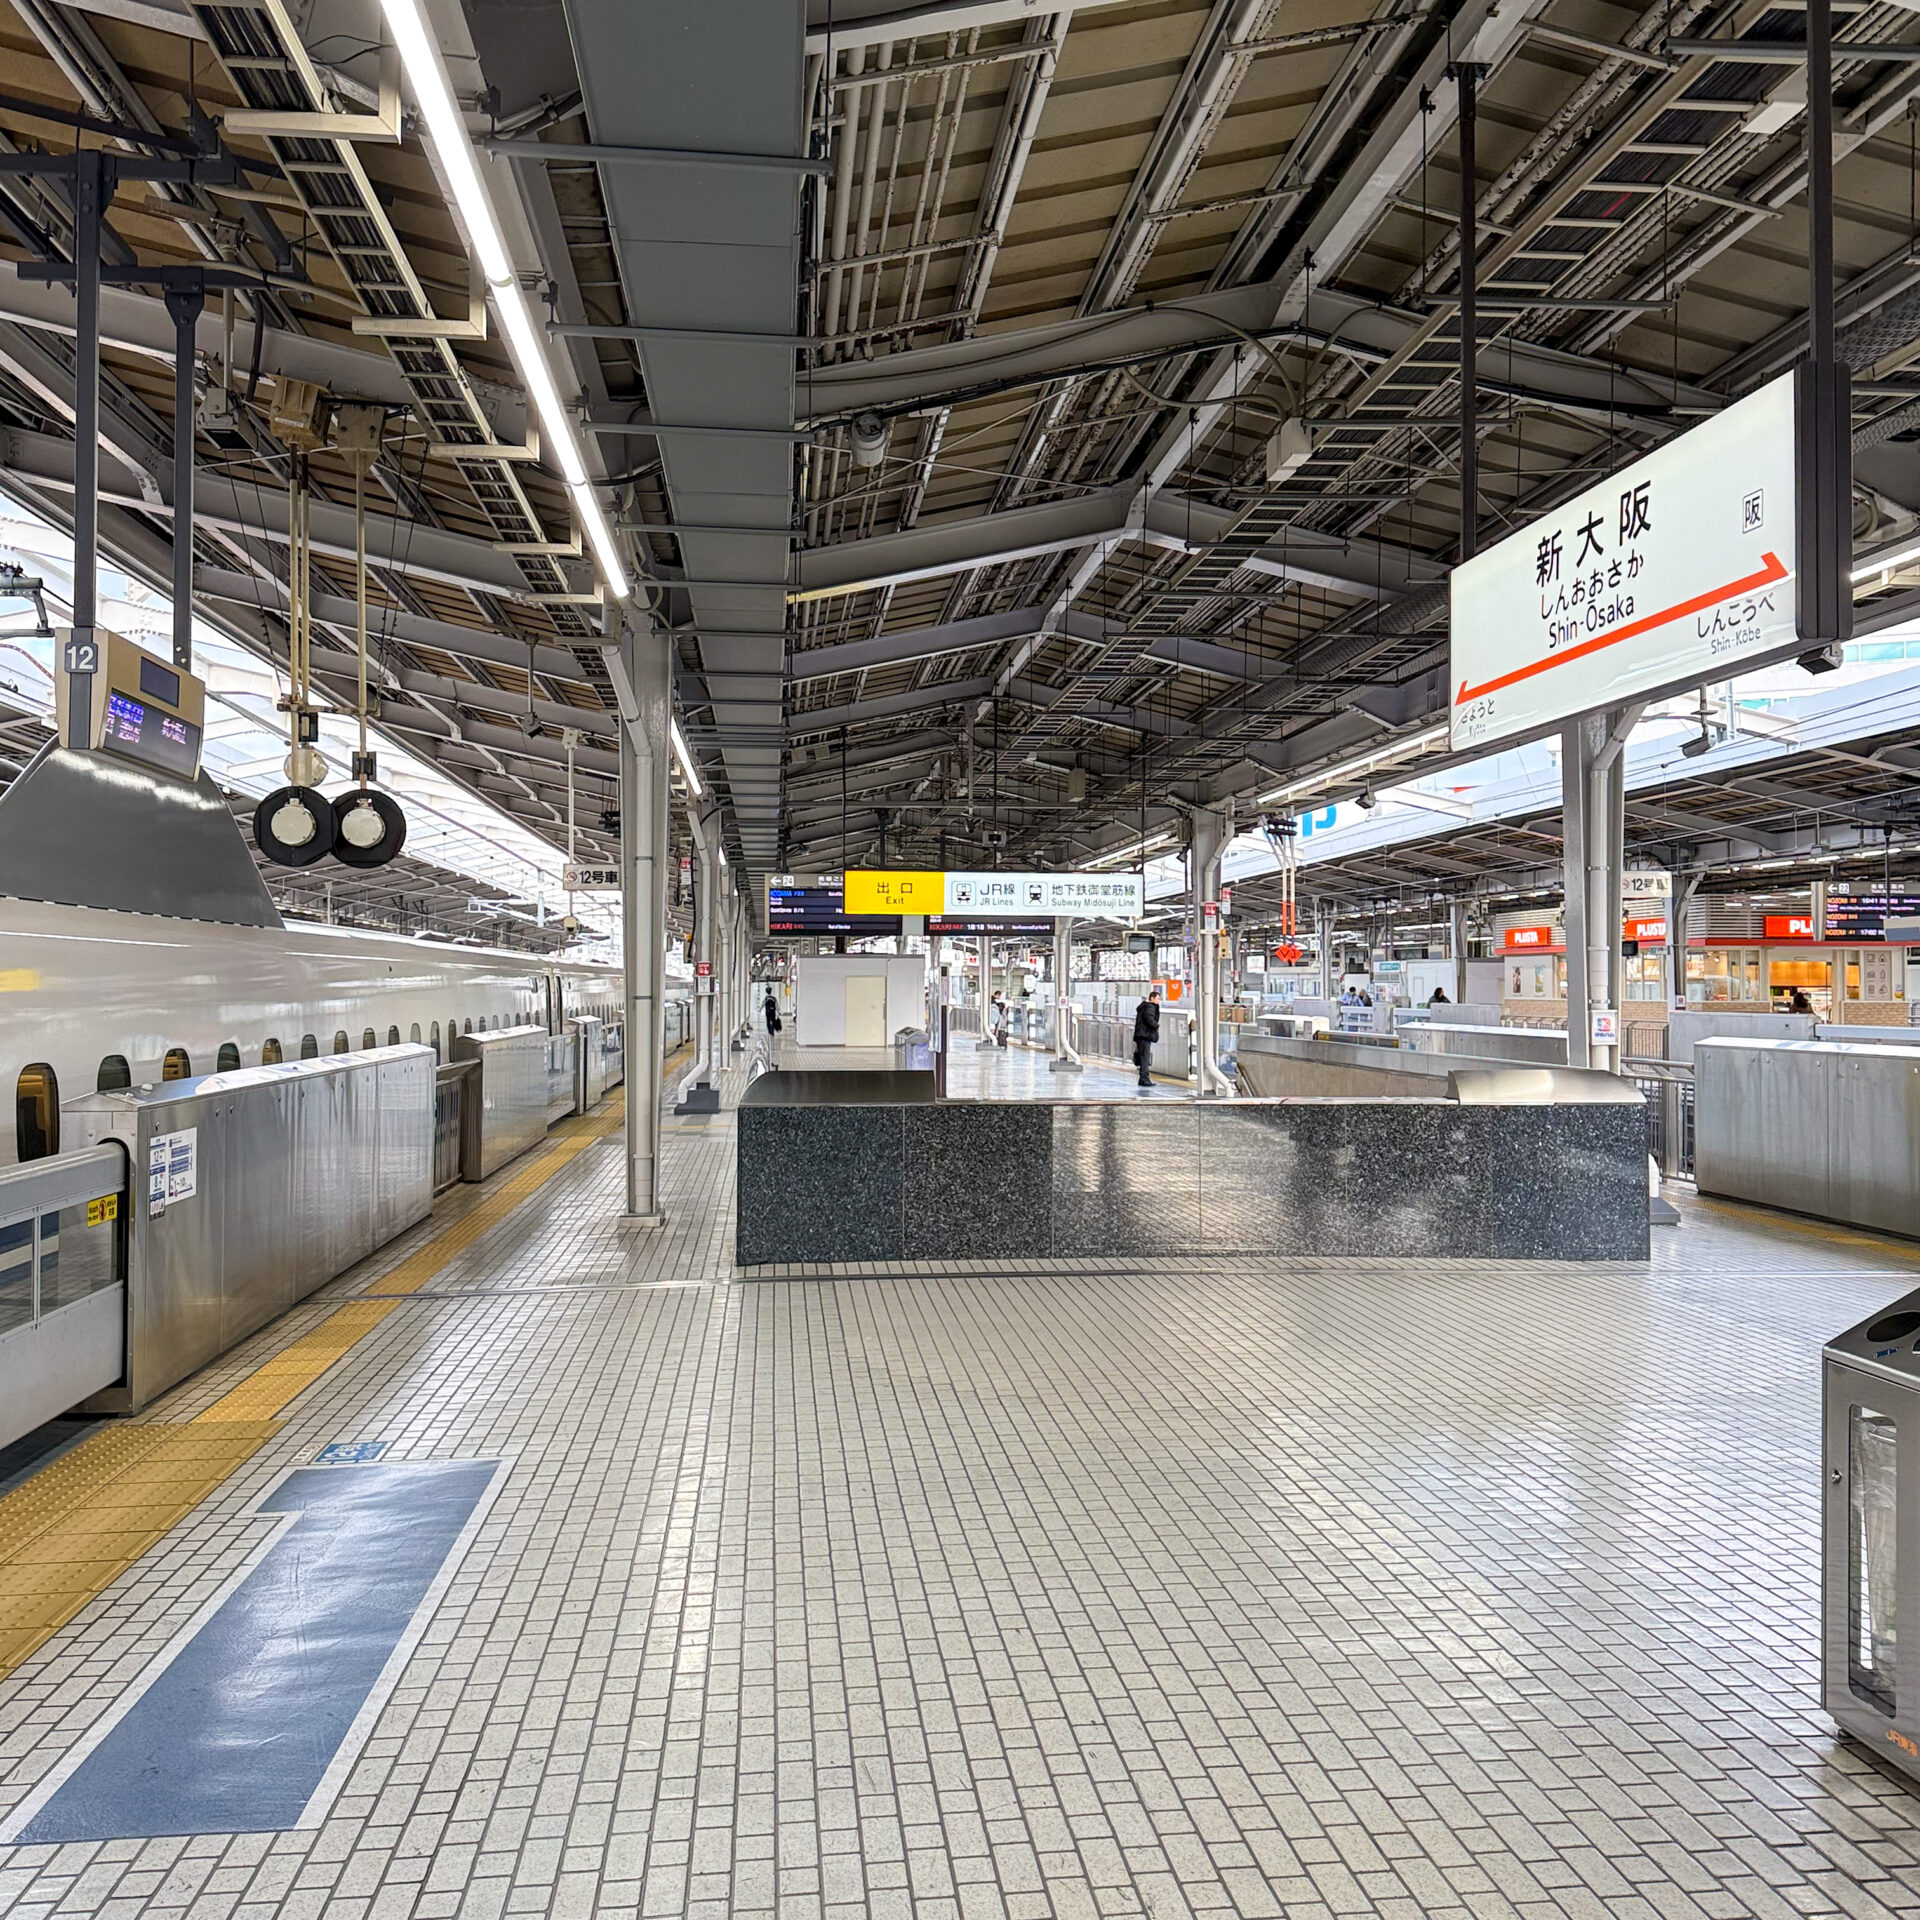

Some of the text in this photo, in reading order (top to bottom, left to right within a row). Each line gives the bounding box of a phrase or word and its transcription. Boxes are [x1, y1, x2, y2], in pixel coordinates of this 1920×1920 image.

[1745, 495, 1761, 529] 阪
[1536, 480, 1652, 588] 新大阪
[1541, 549, 1644, 620] しんおおさか
[1549, 594, 1635, 649] Shin-Ōsaka
[1698, 592, 1775, 639] しんこうべ
[1711, 626, 1761, 655] Shin-Kōbe
[66, 645, 94, 670] 12
[579, 870, 618, 884] 12号車
[877, 881, 912, 893] 出口
[980, 883, 1015, 896] JR線
[1052, 883, 1135, 896] 地下鉄御堂筋線
[1840, 884, 1849, 893] 22
[886, 896, 904, 904] Exit
[980, 898, 1014, 906] JR Lines
[1051, 897, 1135, 909] Subway Midōsuji Line
[1514, 931, 1539, 944] PLUSTA
